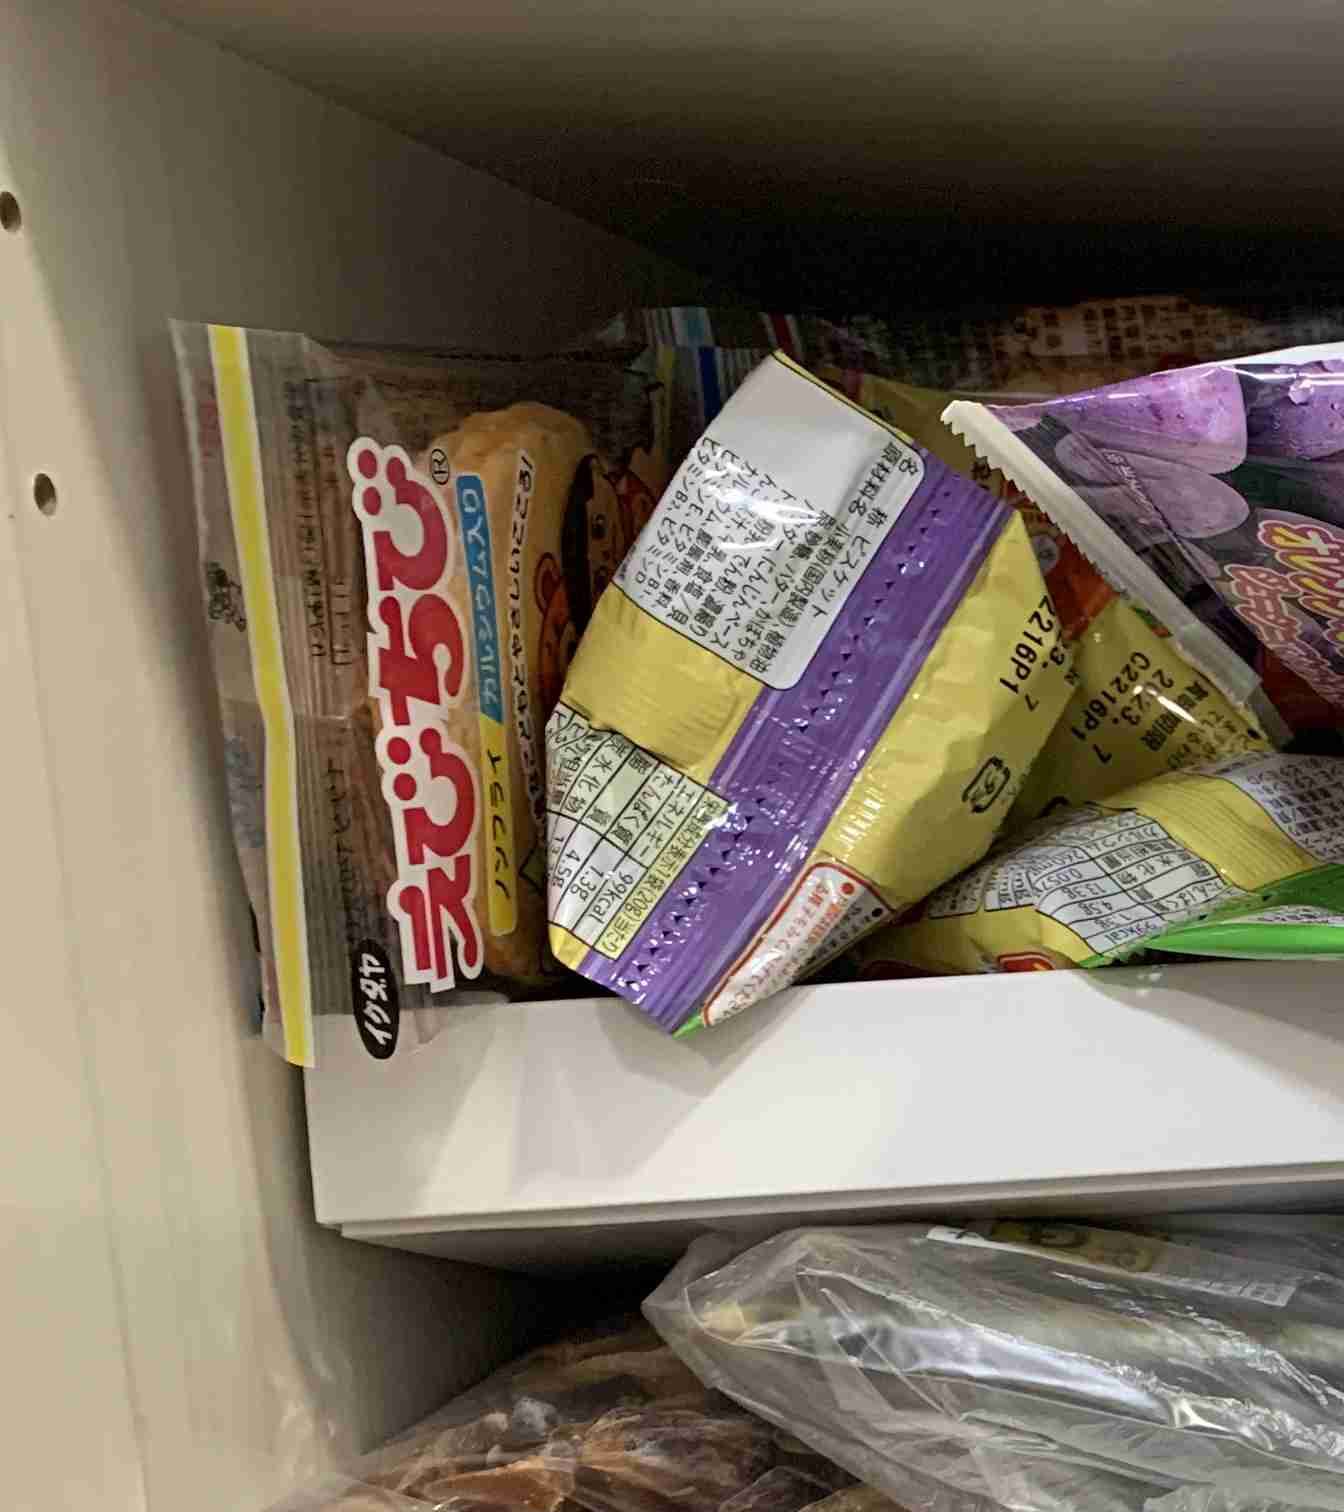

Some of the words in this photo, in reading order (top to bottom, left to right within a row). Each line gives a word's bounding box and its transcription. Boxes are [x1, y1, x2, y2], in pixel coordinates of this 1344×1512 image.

[848, 443, 901, 517] 原材料名
[462, 488, 499, 704] カルシウム入り
[812, 536, 871, 618] ビスケット
[358, 449, 476, 979] えびちび
[490, 750, 510, 900] ノンフライ
